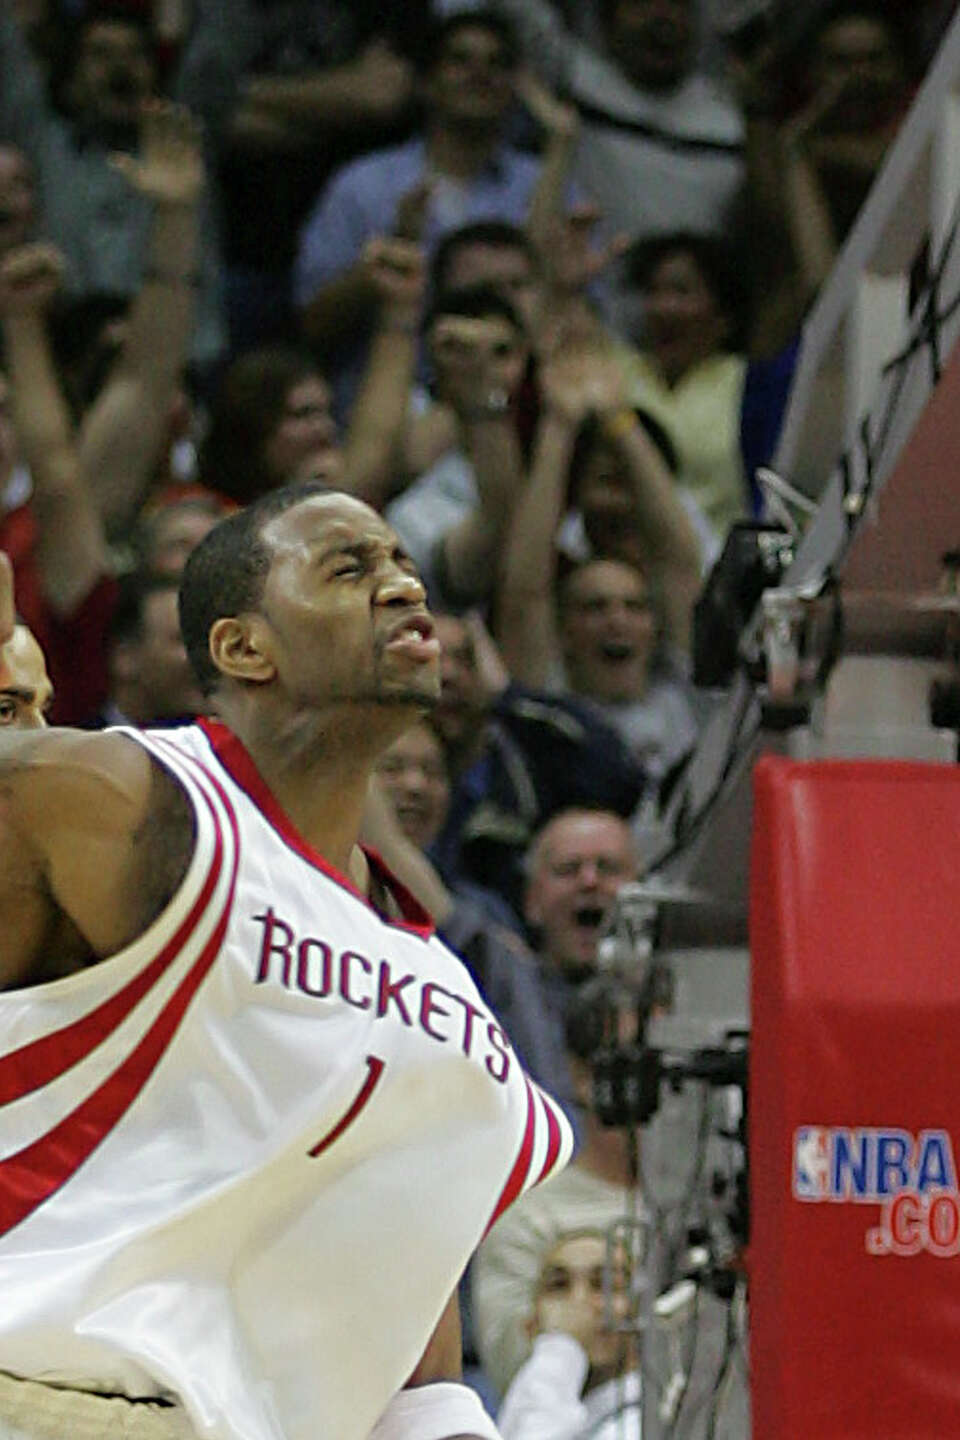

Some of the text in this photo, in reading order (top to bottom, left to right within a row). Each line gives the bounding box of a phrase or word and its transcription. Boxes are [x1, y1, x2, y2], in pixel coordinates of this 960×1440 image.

[251, 907, 511, 1084] ROCKETS
[306, 1055, 385, 1158] 1
[833, 1135, 949, 1195] NBA
